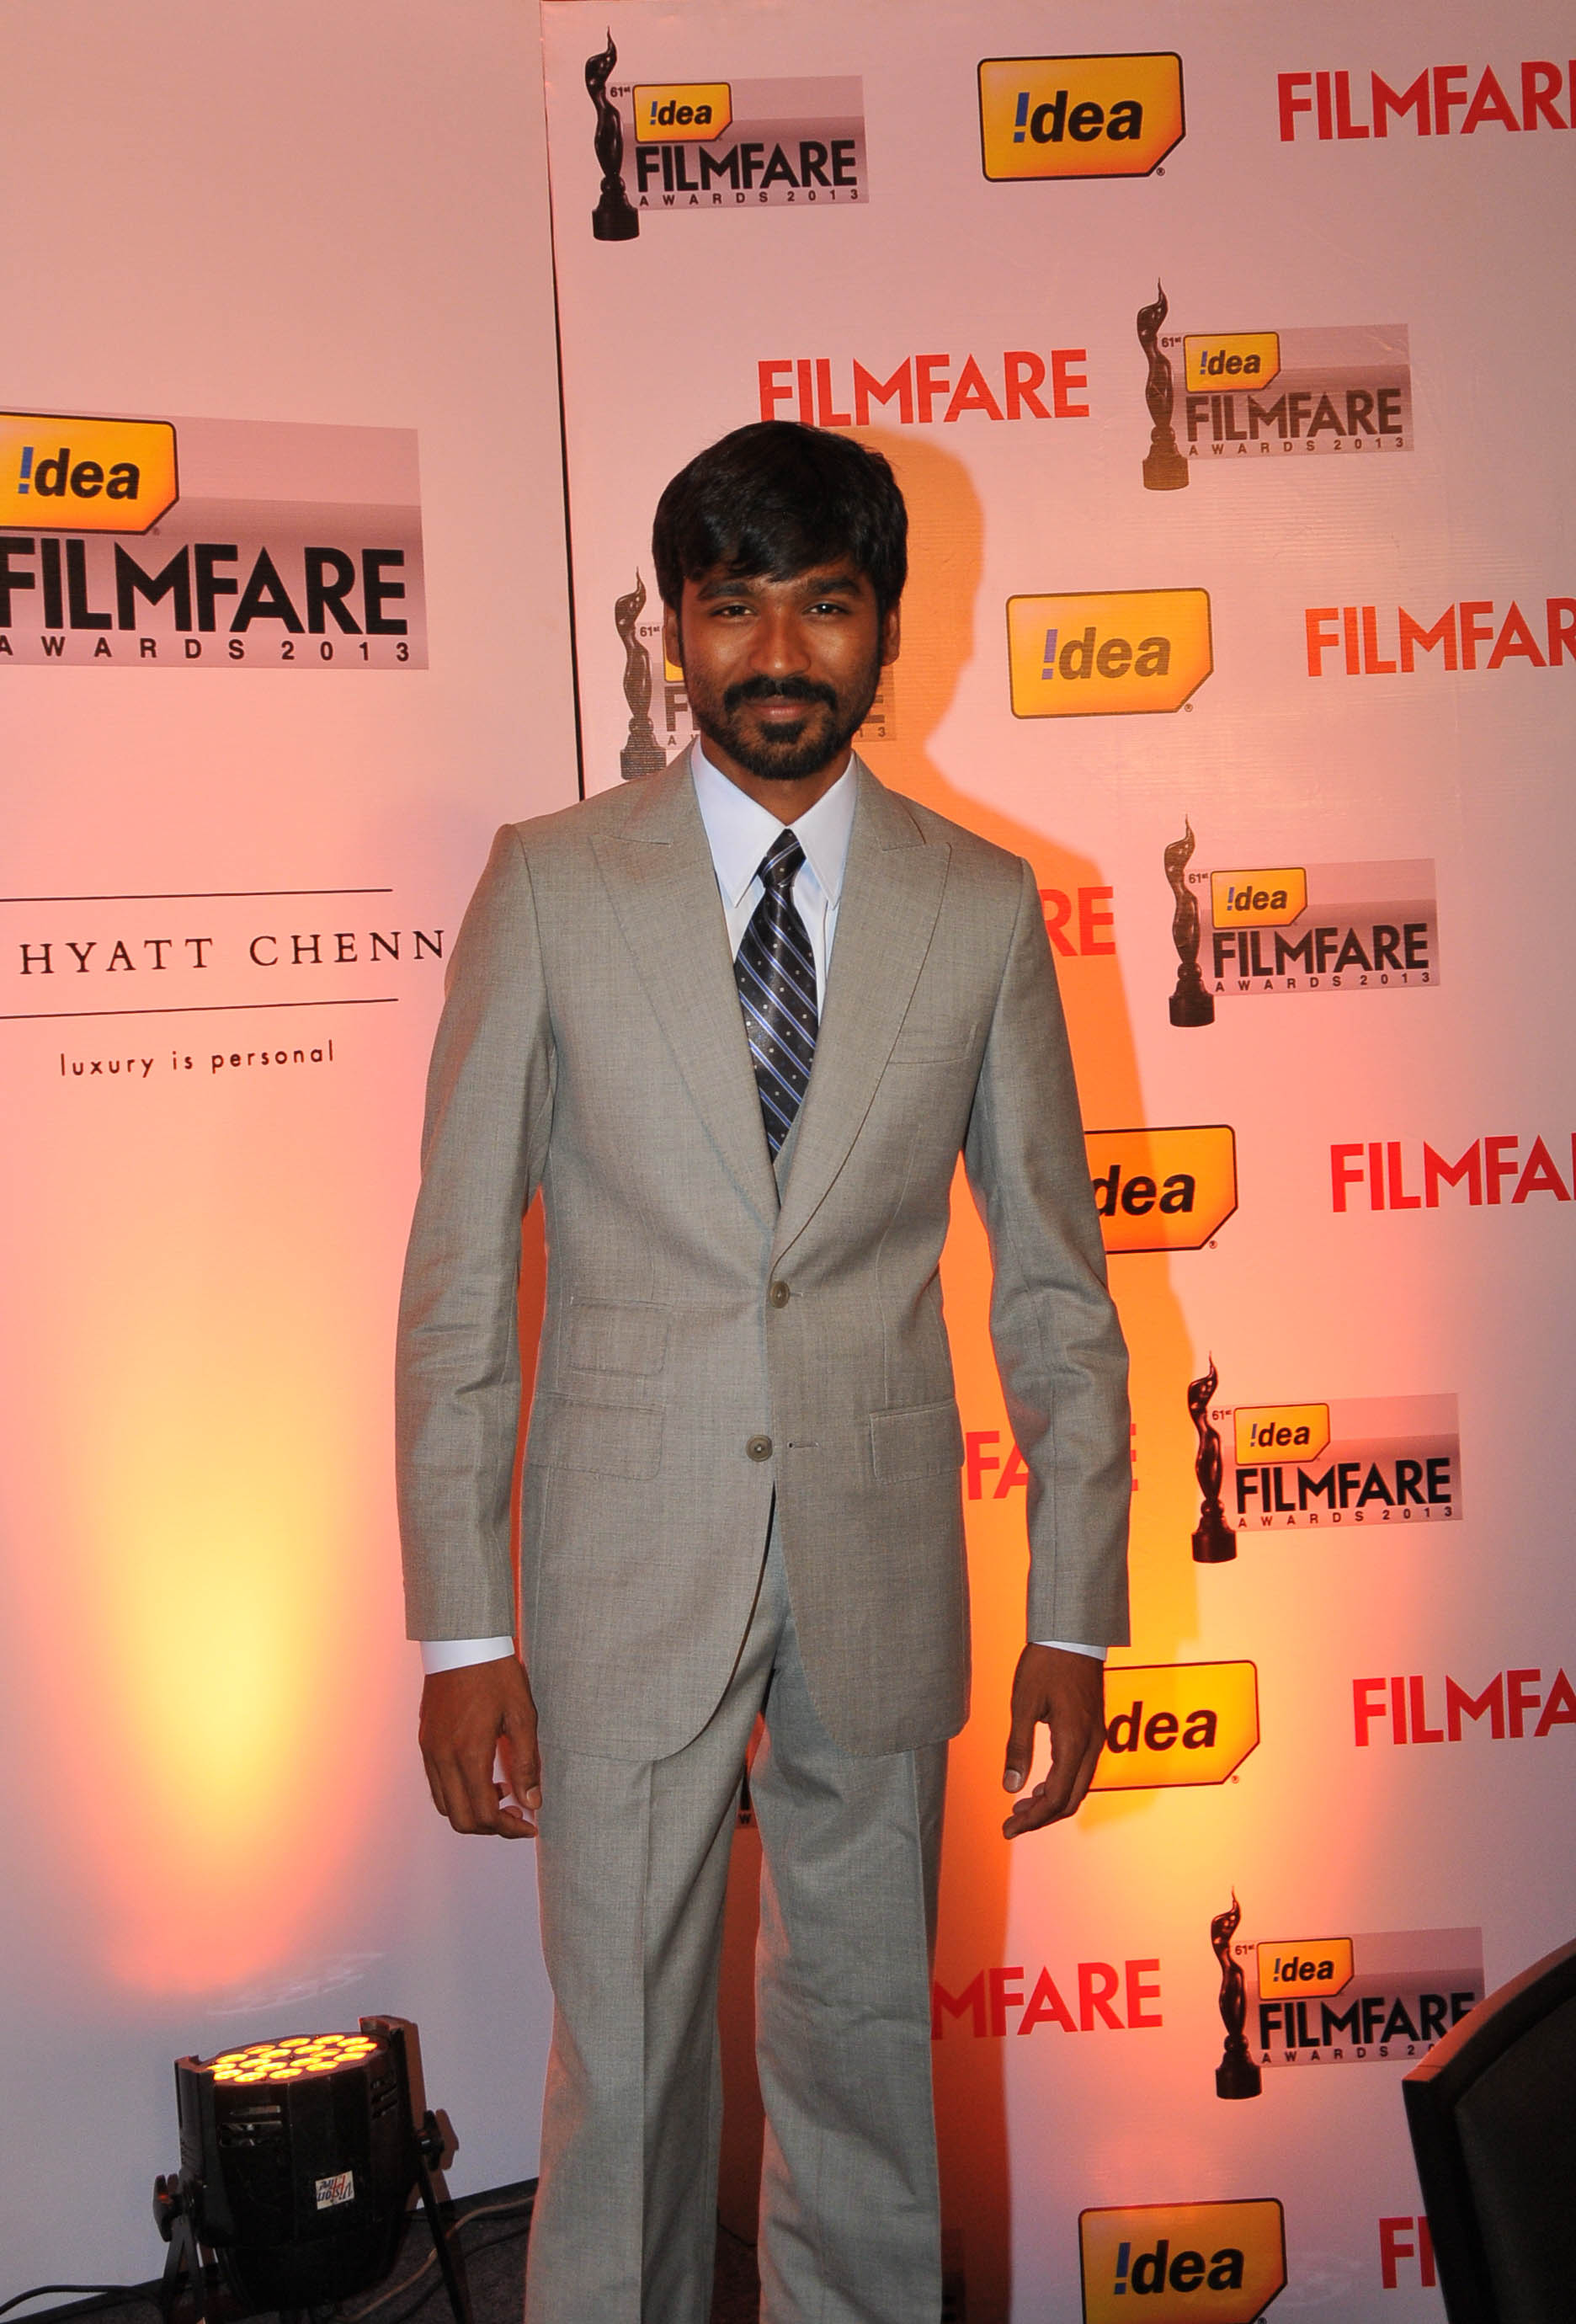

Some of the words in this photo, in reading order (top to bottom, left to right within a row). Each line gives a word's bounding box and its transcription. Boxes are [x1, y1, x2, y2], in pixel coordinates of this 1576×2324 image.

[1277, 59, 1576, 141] FILMFAR
[635, 139, 858, 193] FILMFARE
[639, 191, 769, 207] AWARDS
[787, 189, 859, 202] 2013
[758, 349, 1089, 428] FILMFARE
[1185, 387, 1403, 442] FILMFARE
[1188, 440, 1316, 456] AWARDS
[1334, 436, 1403, 450] 2013
[0, 536, 408, 636] FILMFARE
[0, 635, 245, 660] AWARDS
[281, 640, 409, 662] 2013
[19, 937, 213, 975] HYATT
[1211, 922, 1430, 979] FILMFARE
[1215, 976, 1342, 993] AWARDS
[1359, 972, 1430, 986] 2013
[60, 1053, 154, 1079] luxury
[172, 1050, 194, 1070] is
[211, 1039, 333, 1074] personal
[1330, 1132, 1576, 1213] FILMFA
[1235, 1456, 1452, 1515] FILMFARE
[1238, 1511, 1365, 1528] AWARDS
[1382, 1506, 1453, 1521] 2013
[1261, 2045, 1389, 2064] AWARDS
